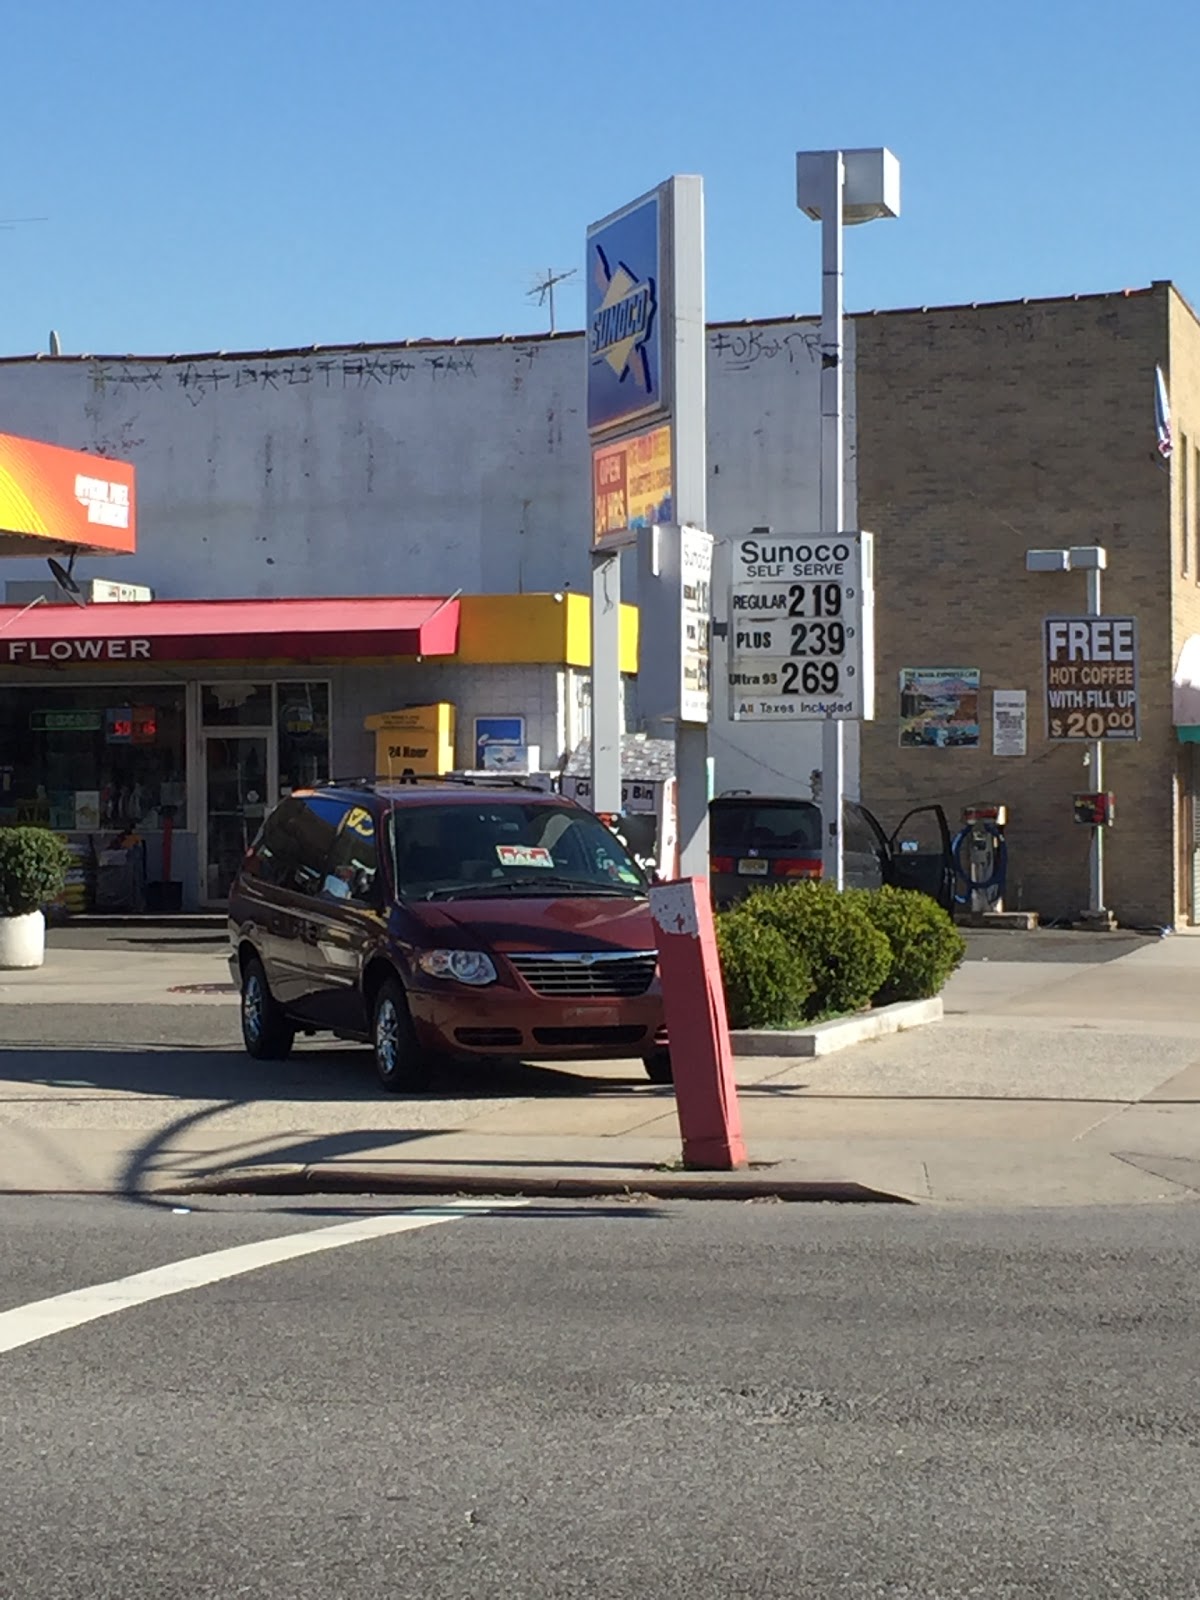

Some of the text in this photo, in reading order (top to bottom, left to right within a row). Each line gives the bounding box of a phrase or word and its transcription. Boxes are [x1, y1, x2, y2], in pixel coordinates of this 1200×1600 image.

[591, 287, 649, 354] SUNOCO
[740, 540, 850, 564] Sunoco
[746, 563, 844, 578] SELF SERVE
[733, 594, 787, 610] REGULAR
[788, 583, 842, 617] 219
[8, 639, 151, 661] FLOWER
[736, 631, 772, 649] PLUS
[790, 622, 846, 657] 239
[1049, 621, 1133, 661] FREE
[729, 673, 760, 686] Ultra
[762, 672, 778, 685] 93
[781, 661, 840, 695] 269
[1050, 666, 1134, 685] HOT COFFEE
[760, 703, 795, 714] Taxes
[800, 701, 853, 713] Included
[1048, 690, 1136, 709] WITH FILL UP
[632, 786, 654, 799] Bin
